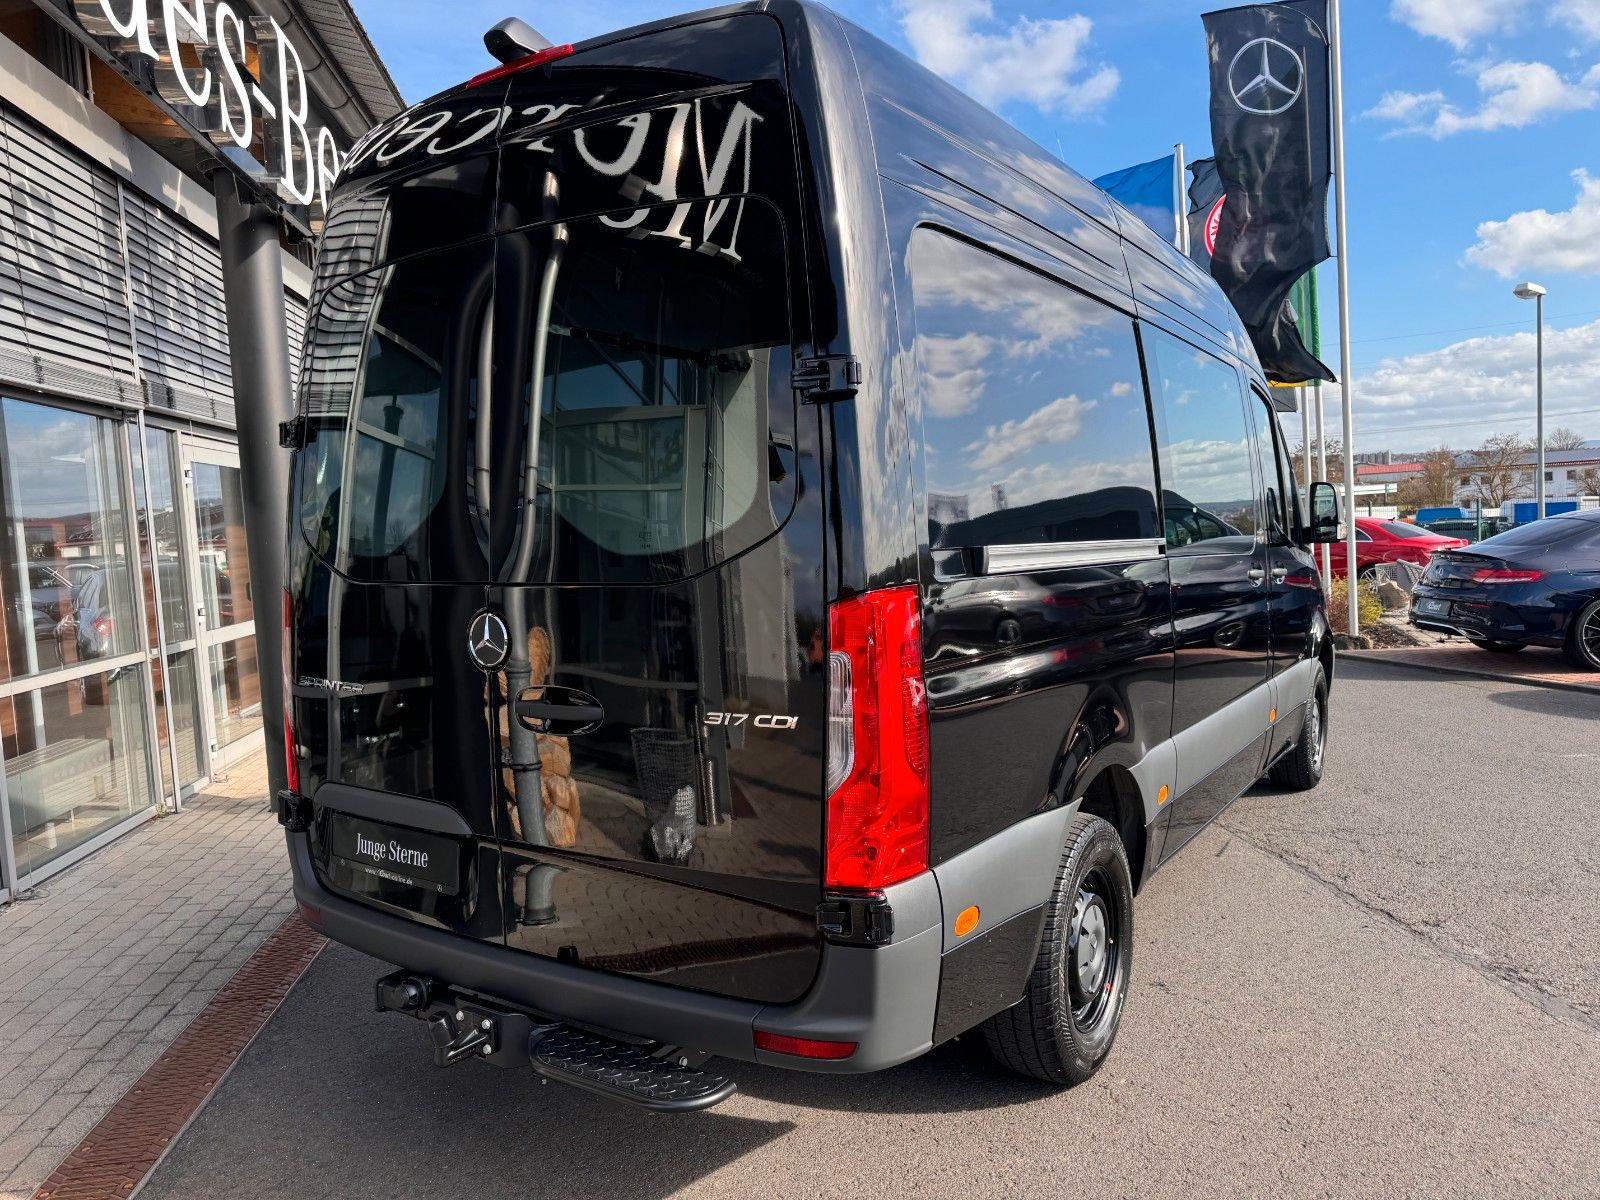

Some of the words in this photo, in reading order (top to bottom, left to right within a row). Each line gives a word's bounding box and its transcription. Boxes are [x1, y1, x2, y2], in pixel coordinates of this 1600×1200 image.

[299, 676, 364, 695] SPRINTER
[704, 712, 749, 726] 317
[754, 714, 799, 729] CDI
[356, 833, 386, 861] Junge
[388, 840, 428, 868] Sterne
